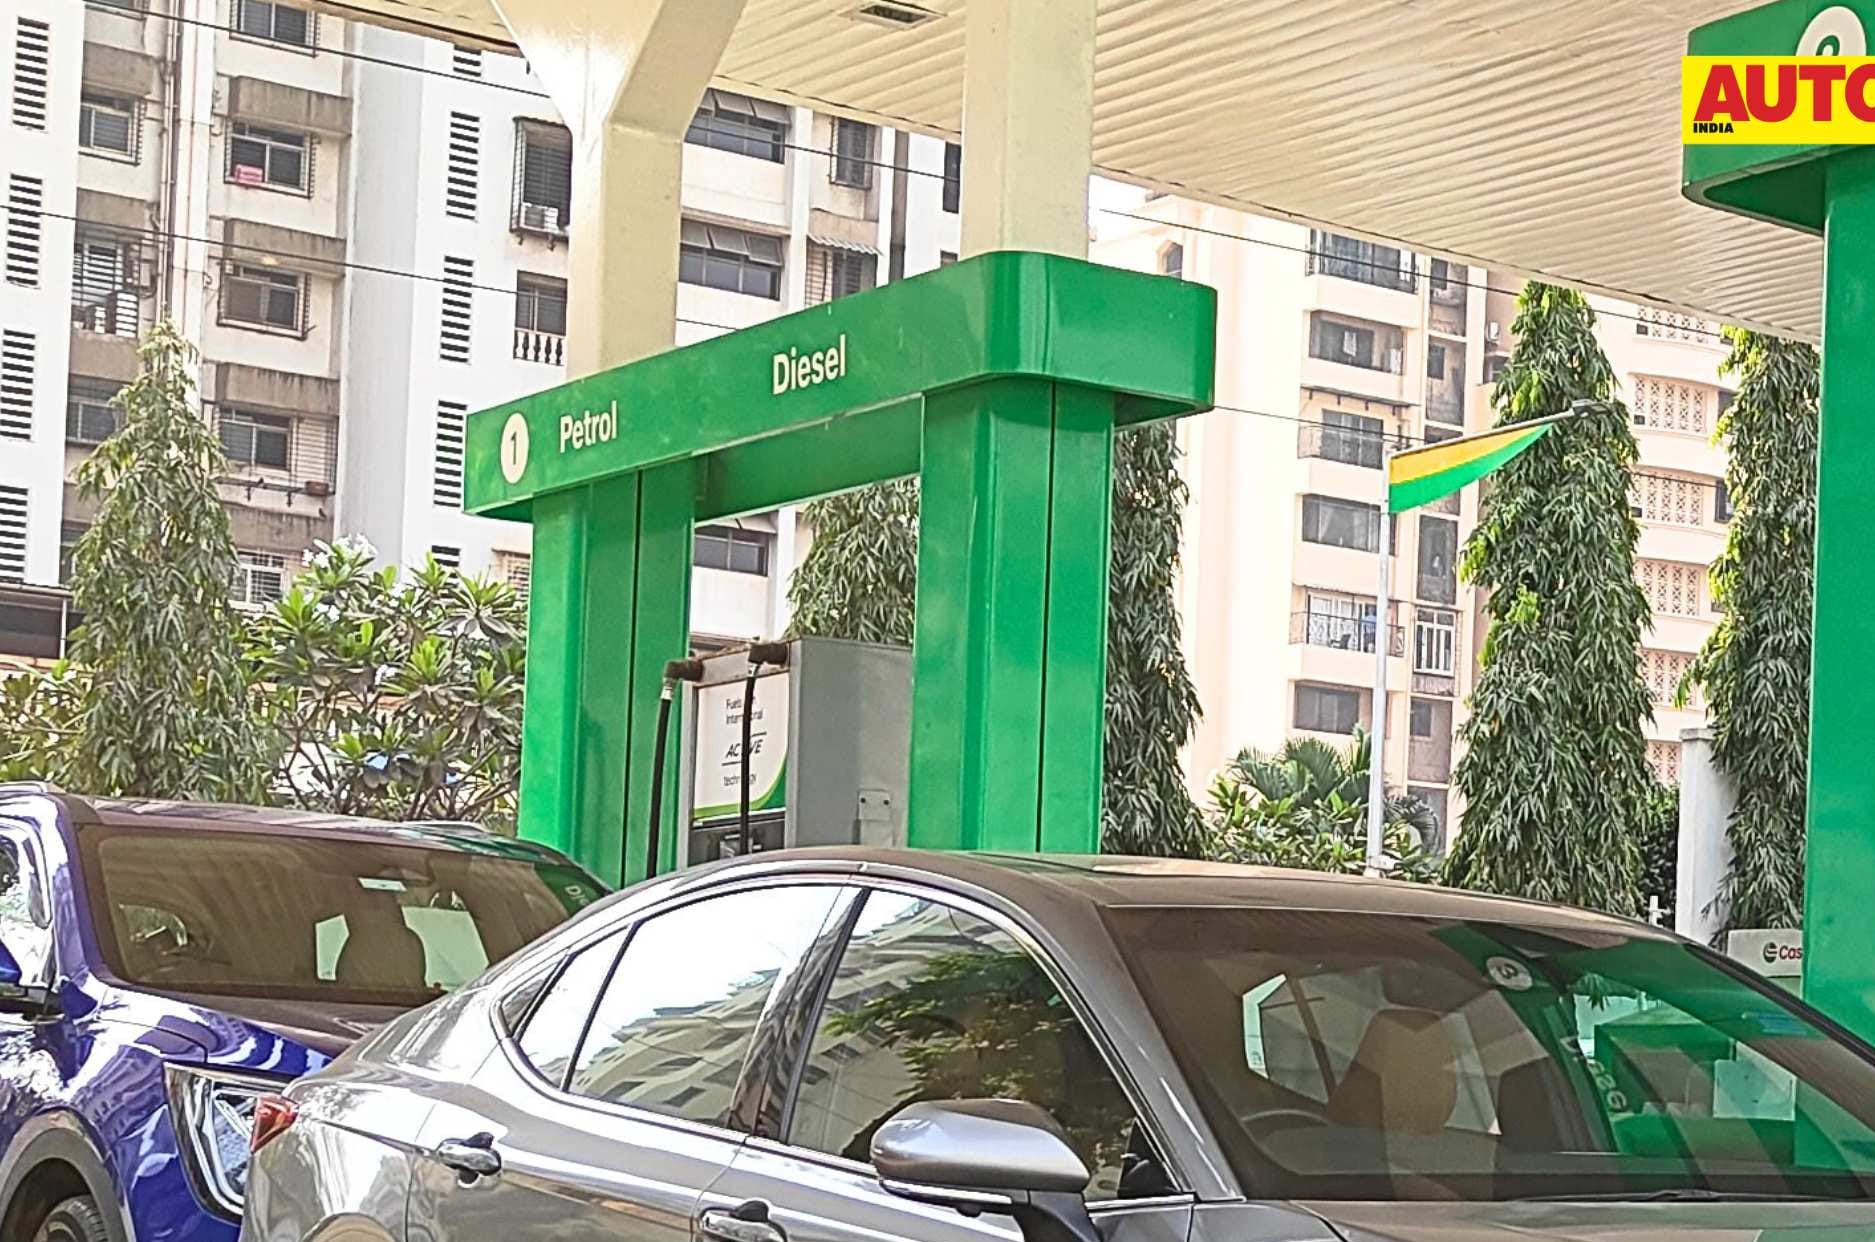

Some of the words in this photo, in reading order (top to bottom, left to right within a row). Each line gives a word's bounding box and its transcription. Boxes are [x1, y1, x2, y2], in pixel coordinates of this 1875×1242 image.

[510, 432, 518, 465] 1
[560, 400, 618, 453] Petrol
[772, 334, 846, 395] Diesel
